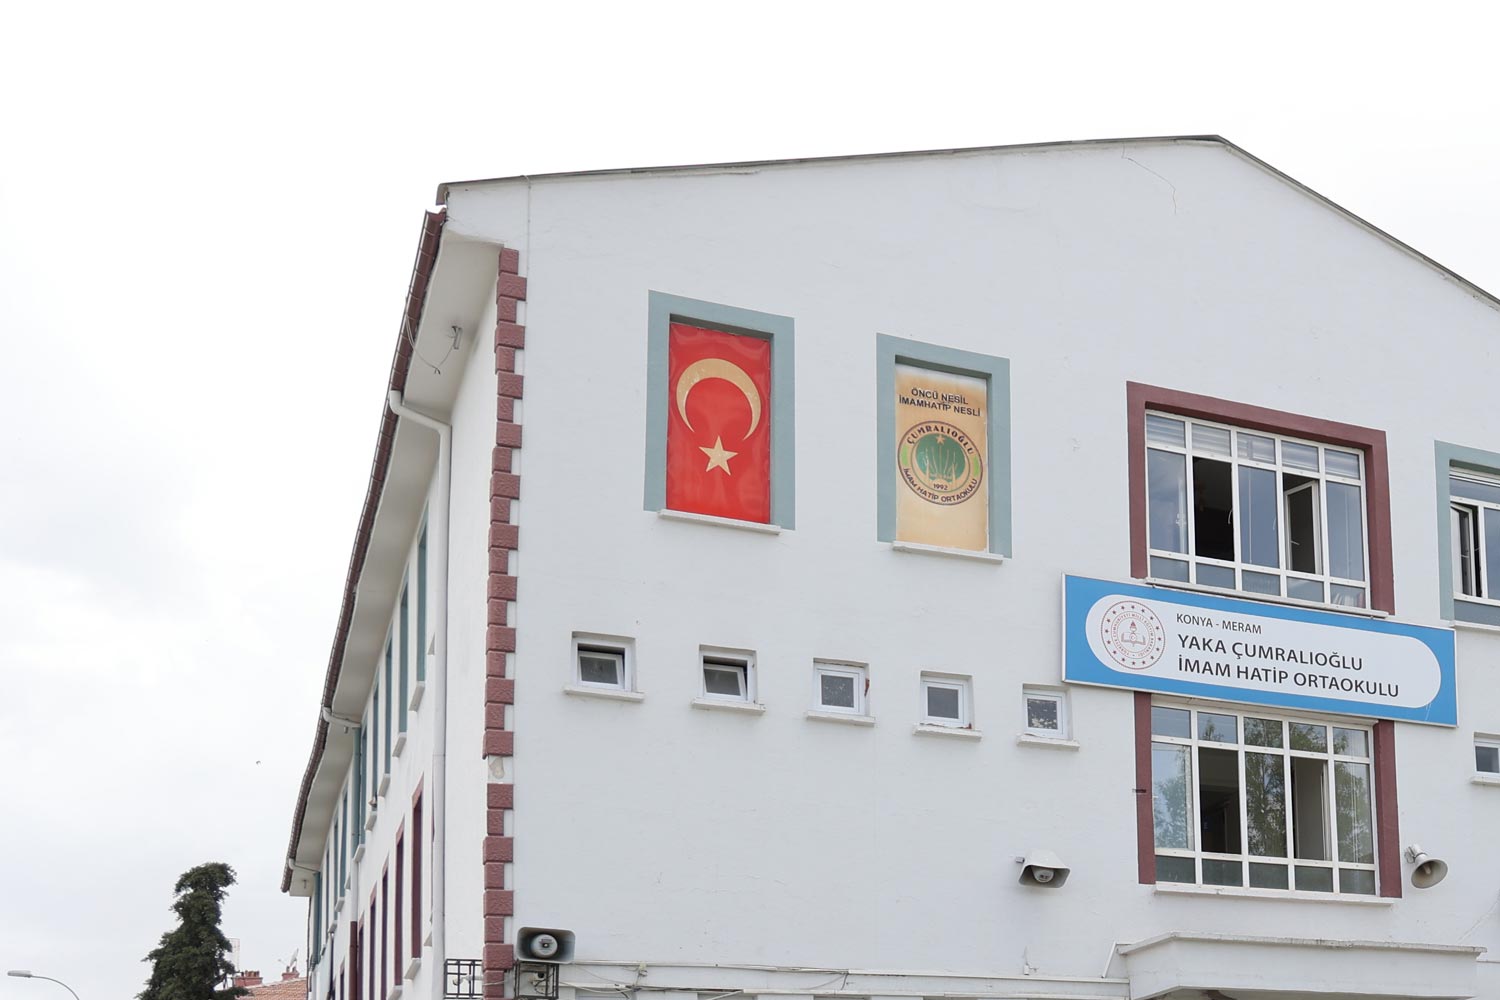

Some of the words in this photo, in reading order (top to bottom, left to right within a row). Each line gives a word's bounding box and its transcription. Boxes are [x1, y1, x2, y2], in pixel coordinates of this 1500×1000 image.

[911, 387, 939, 400] ÖNCÜ
[941, 393, 969, 405] NESİL
[907, 424, 974, 454] ÇUMRALIOĞLU
[940, 479, 978, 502] ORTAOKULU
[1177, 613, 1213, 628] KONYA
[1222, 620, 1262, 634] MERAM
[1178, 634, 1227, 654] YAKA
[1231, 642, 1363, 671] ÇUMRALIOĞLU
[1179, 654, 1231, 678] İMAM
[1237, 665, 1289, 684] HATİP
[1293, 672, 1399, 697] ORTAOKULU
